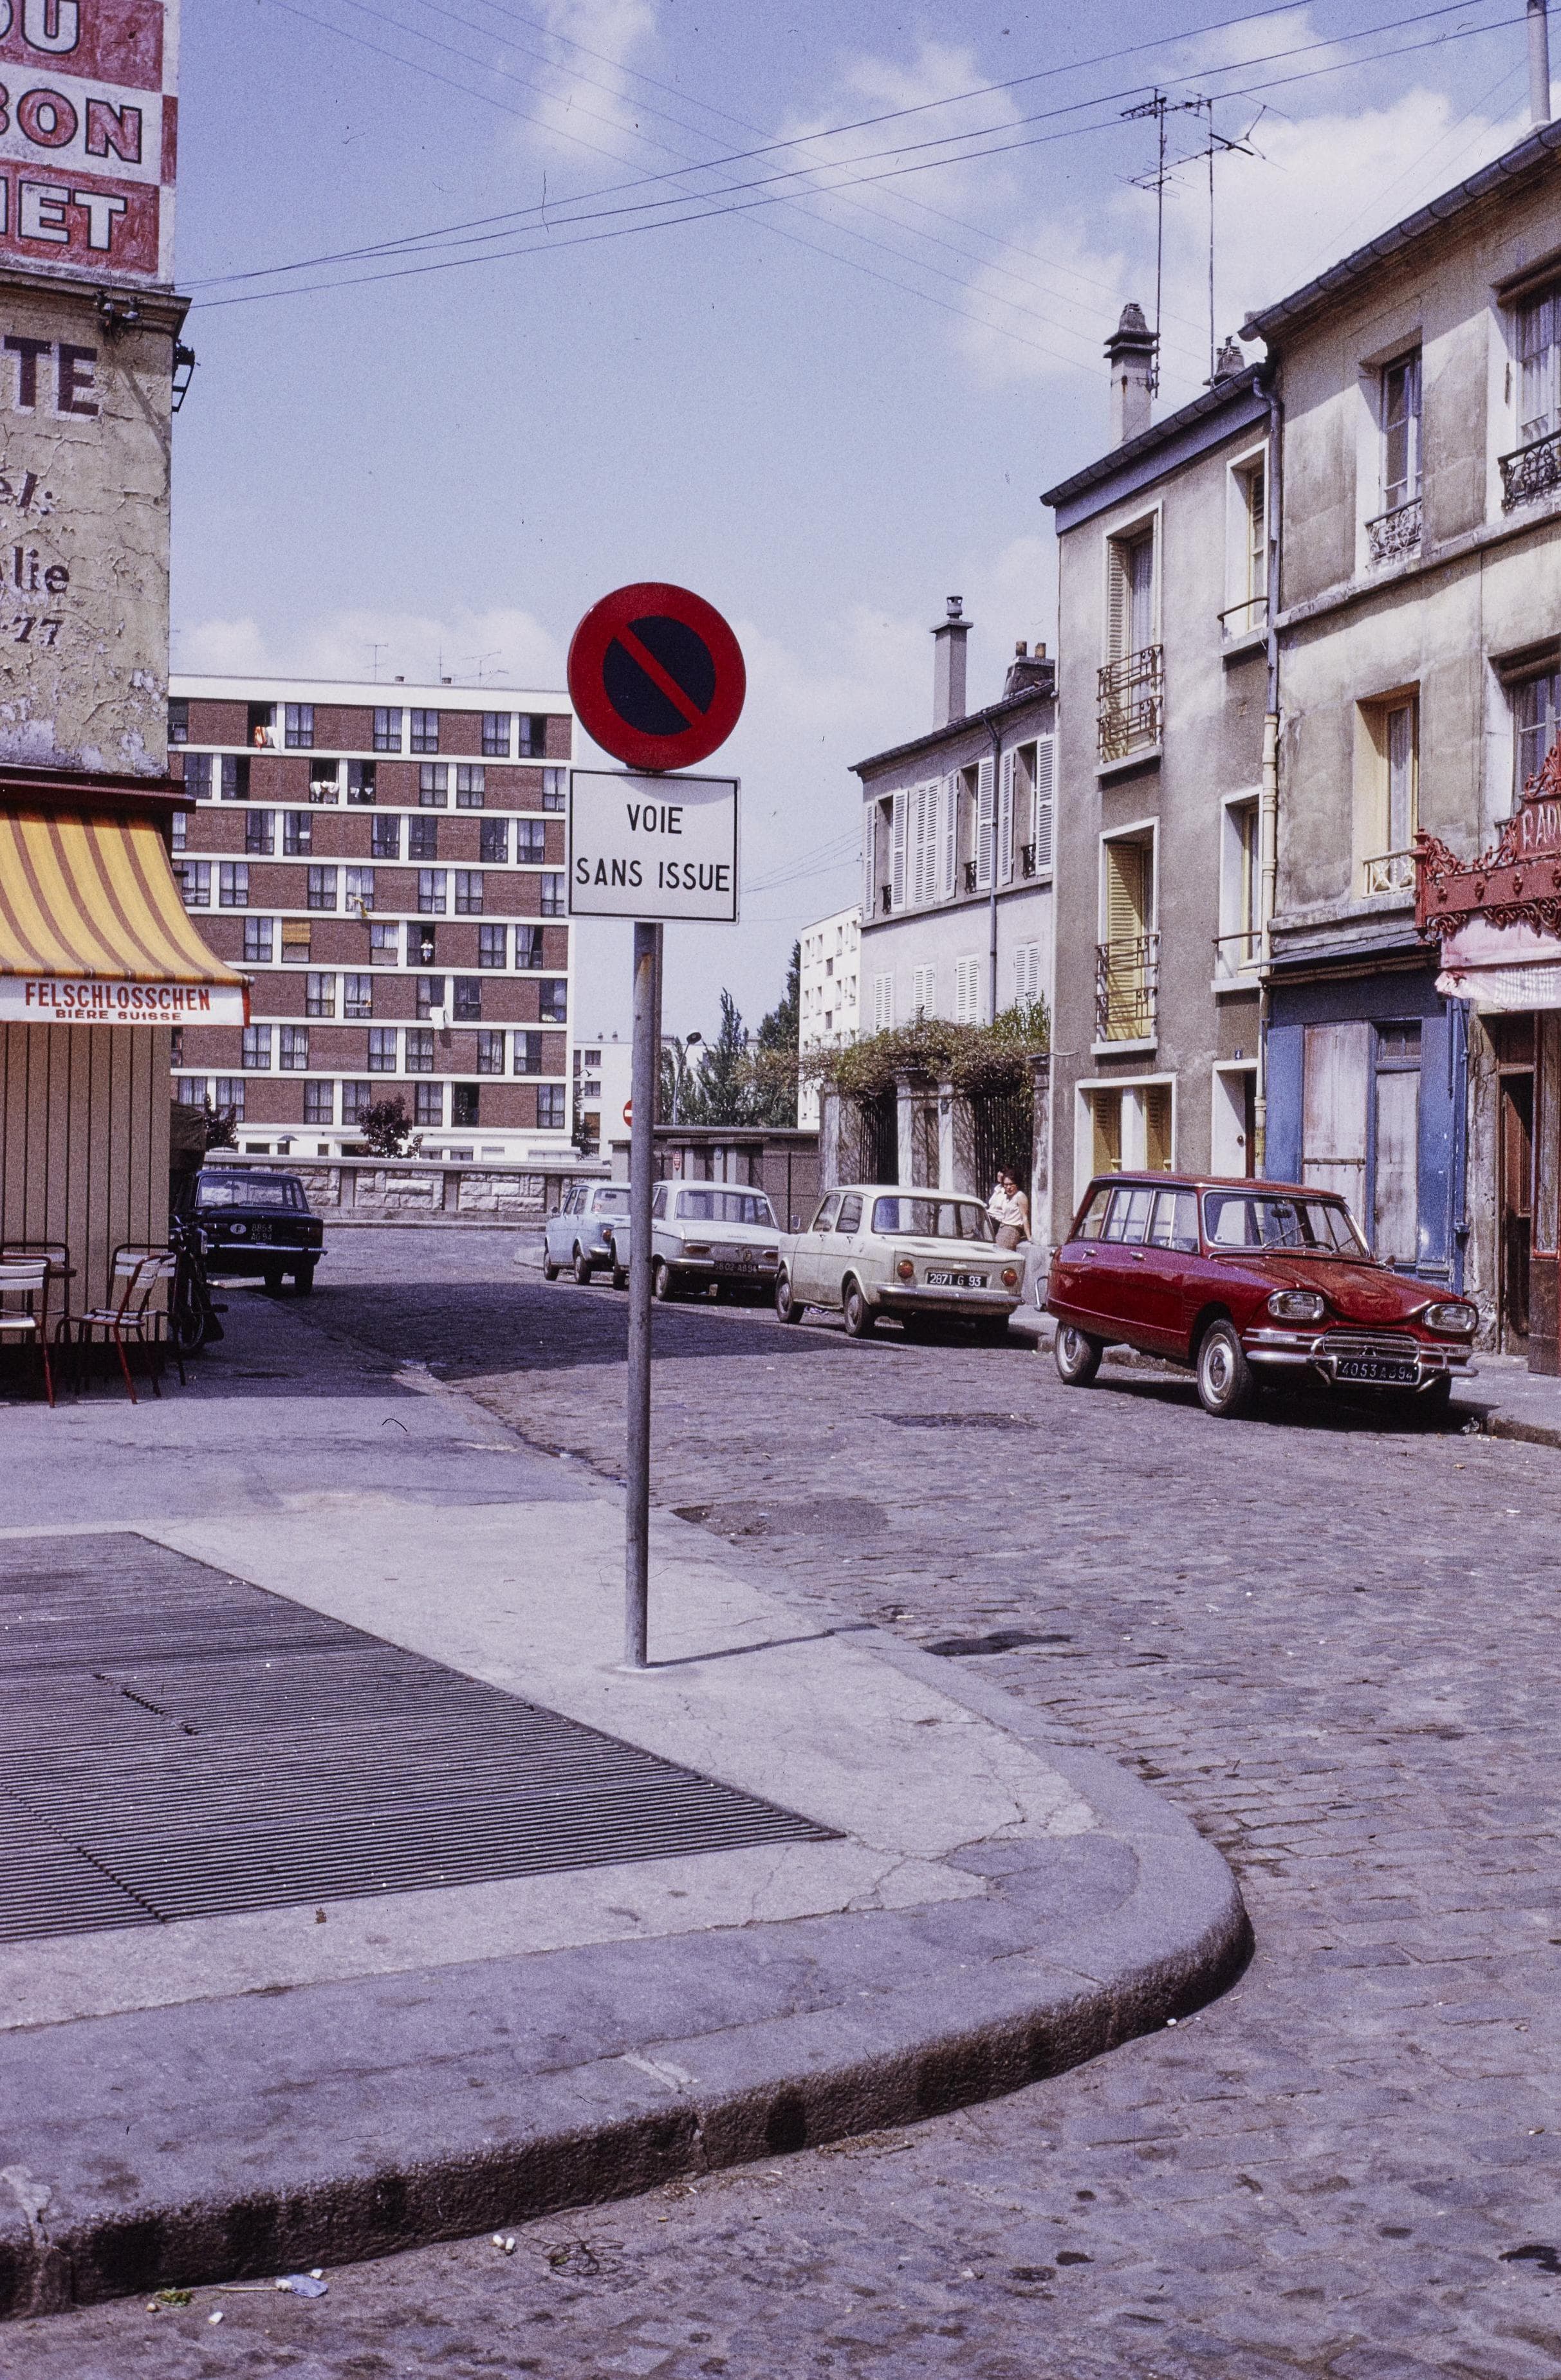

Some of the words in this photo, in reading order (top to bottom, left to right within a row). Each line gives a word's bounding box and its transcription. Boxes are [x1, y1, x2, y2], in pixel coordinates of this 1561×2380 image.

[0, 0, 80, 55] U
[0, 82, 142, 165] ON
[0, 176, 127, 252] ET
[3, 334, 99, 416] TE
[0, 545, 69, 594] lie
[627, 803, 683, 834] VOIE
[1522, 801, 1561, 850] RAD
[576, 857, 642, 887] SANS
[658, 861, 730, 892] ISSUE
[25, 982, 210, 1011] FELSCHLOSSCHEN
[117, 1011, 182, 1021] SUISSE
[930, 1273, 953, 1285] 2871
[957, 1275, 965, 1285] G
[968, 1276, 982, 1287] 93
